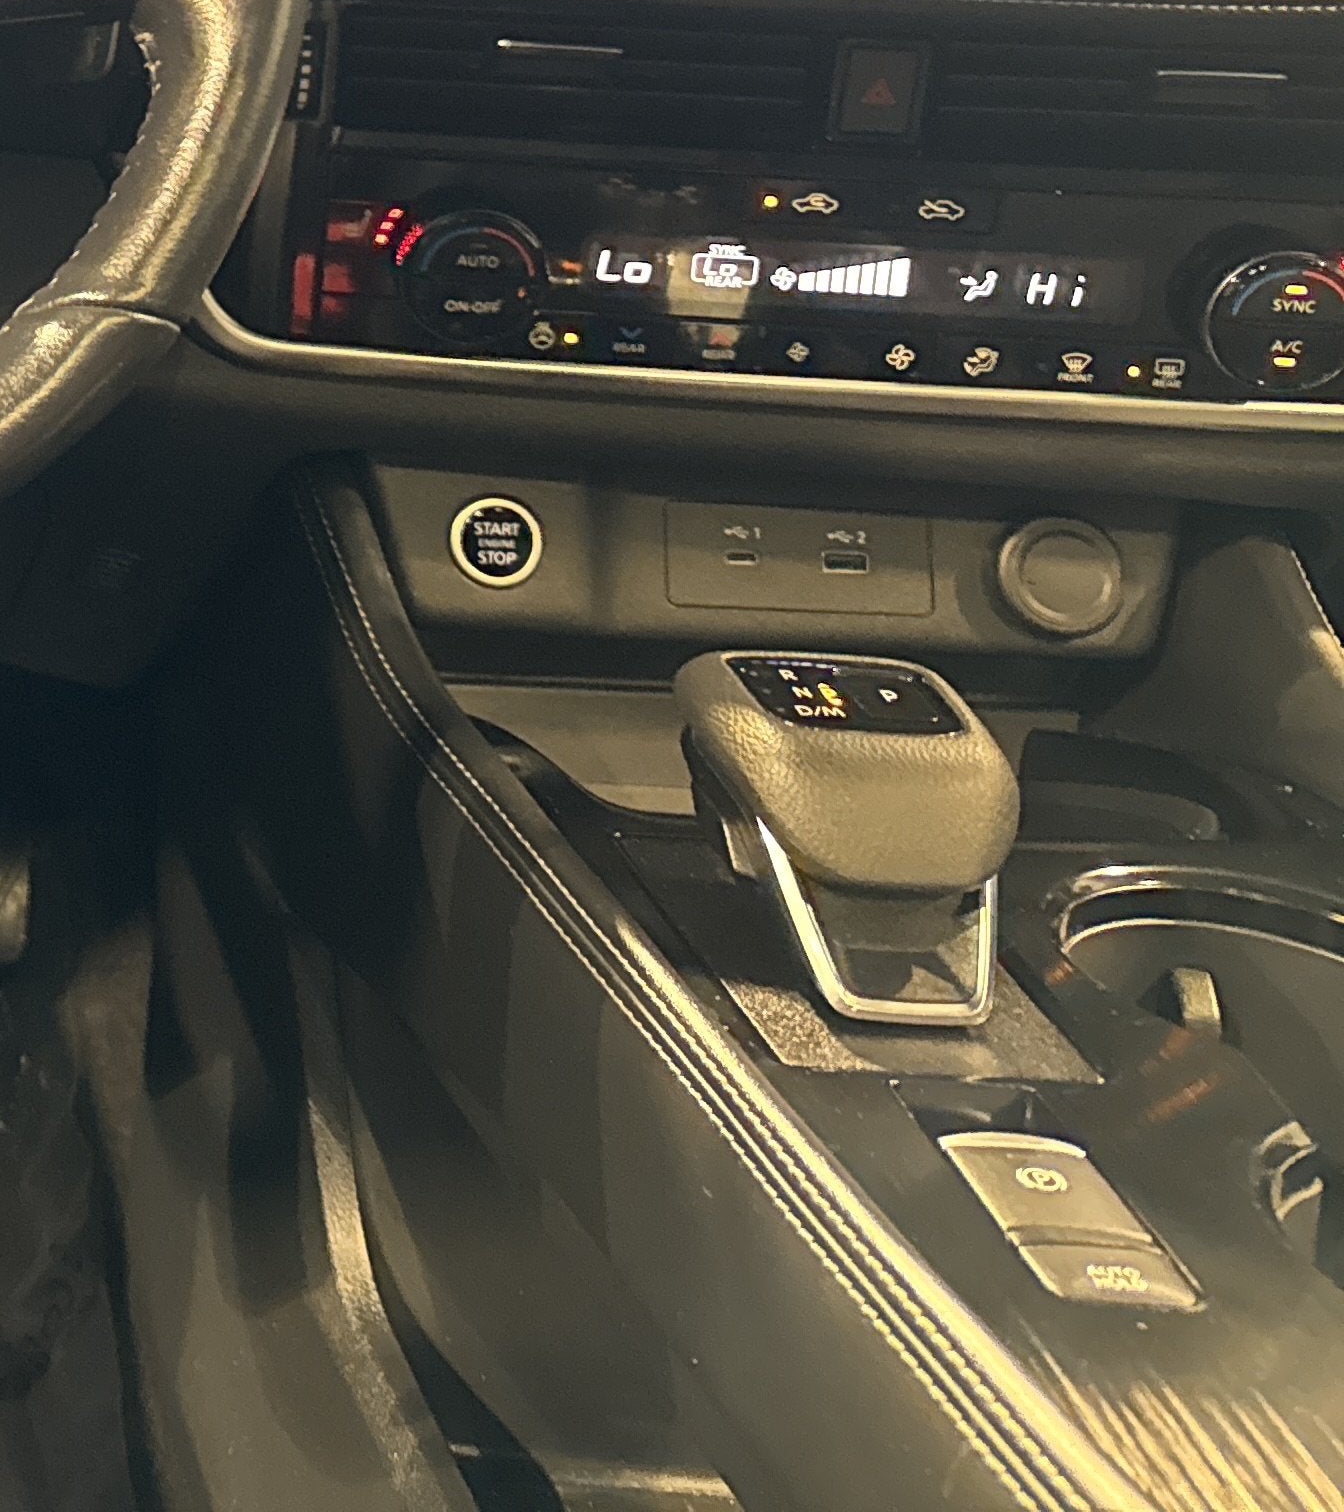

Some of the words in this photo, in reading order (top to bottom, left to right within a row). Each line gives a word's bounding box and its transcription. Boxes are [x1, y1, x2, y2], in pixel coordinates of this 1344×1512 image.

[457, 254, 500, 269] AUTO
[595, 249, 653, 284] Lo
[702, 257, 738, 276] Lo
[1025, 272, 1086, 308] Hi
[1271, 298, 1316, 315] SYNC
[1270, 339, 1304, 354] A/C
[473, 521, 521, 537] START
[477, 549, 519, 566] STOP
[778, 668, 800, 682] R
[791, 686, 814, 700] N
[794, 703, 847, 719] D/M
